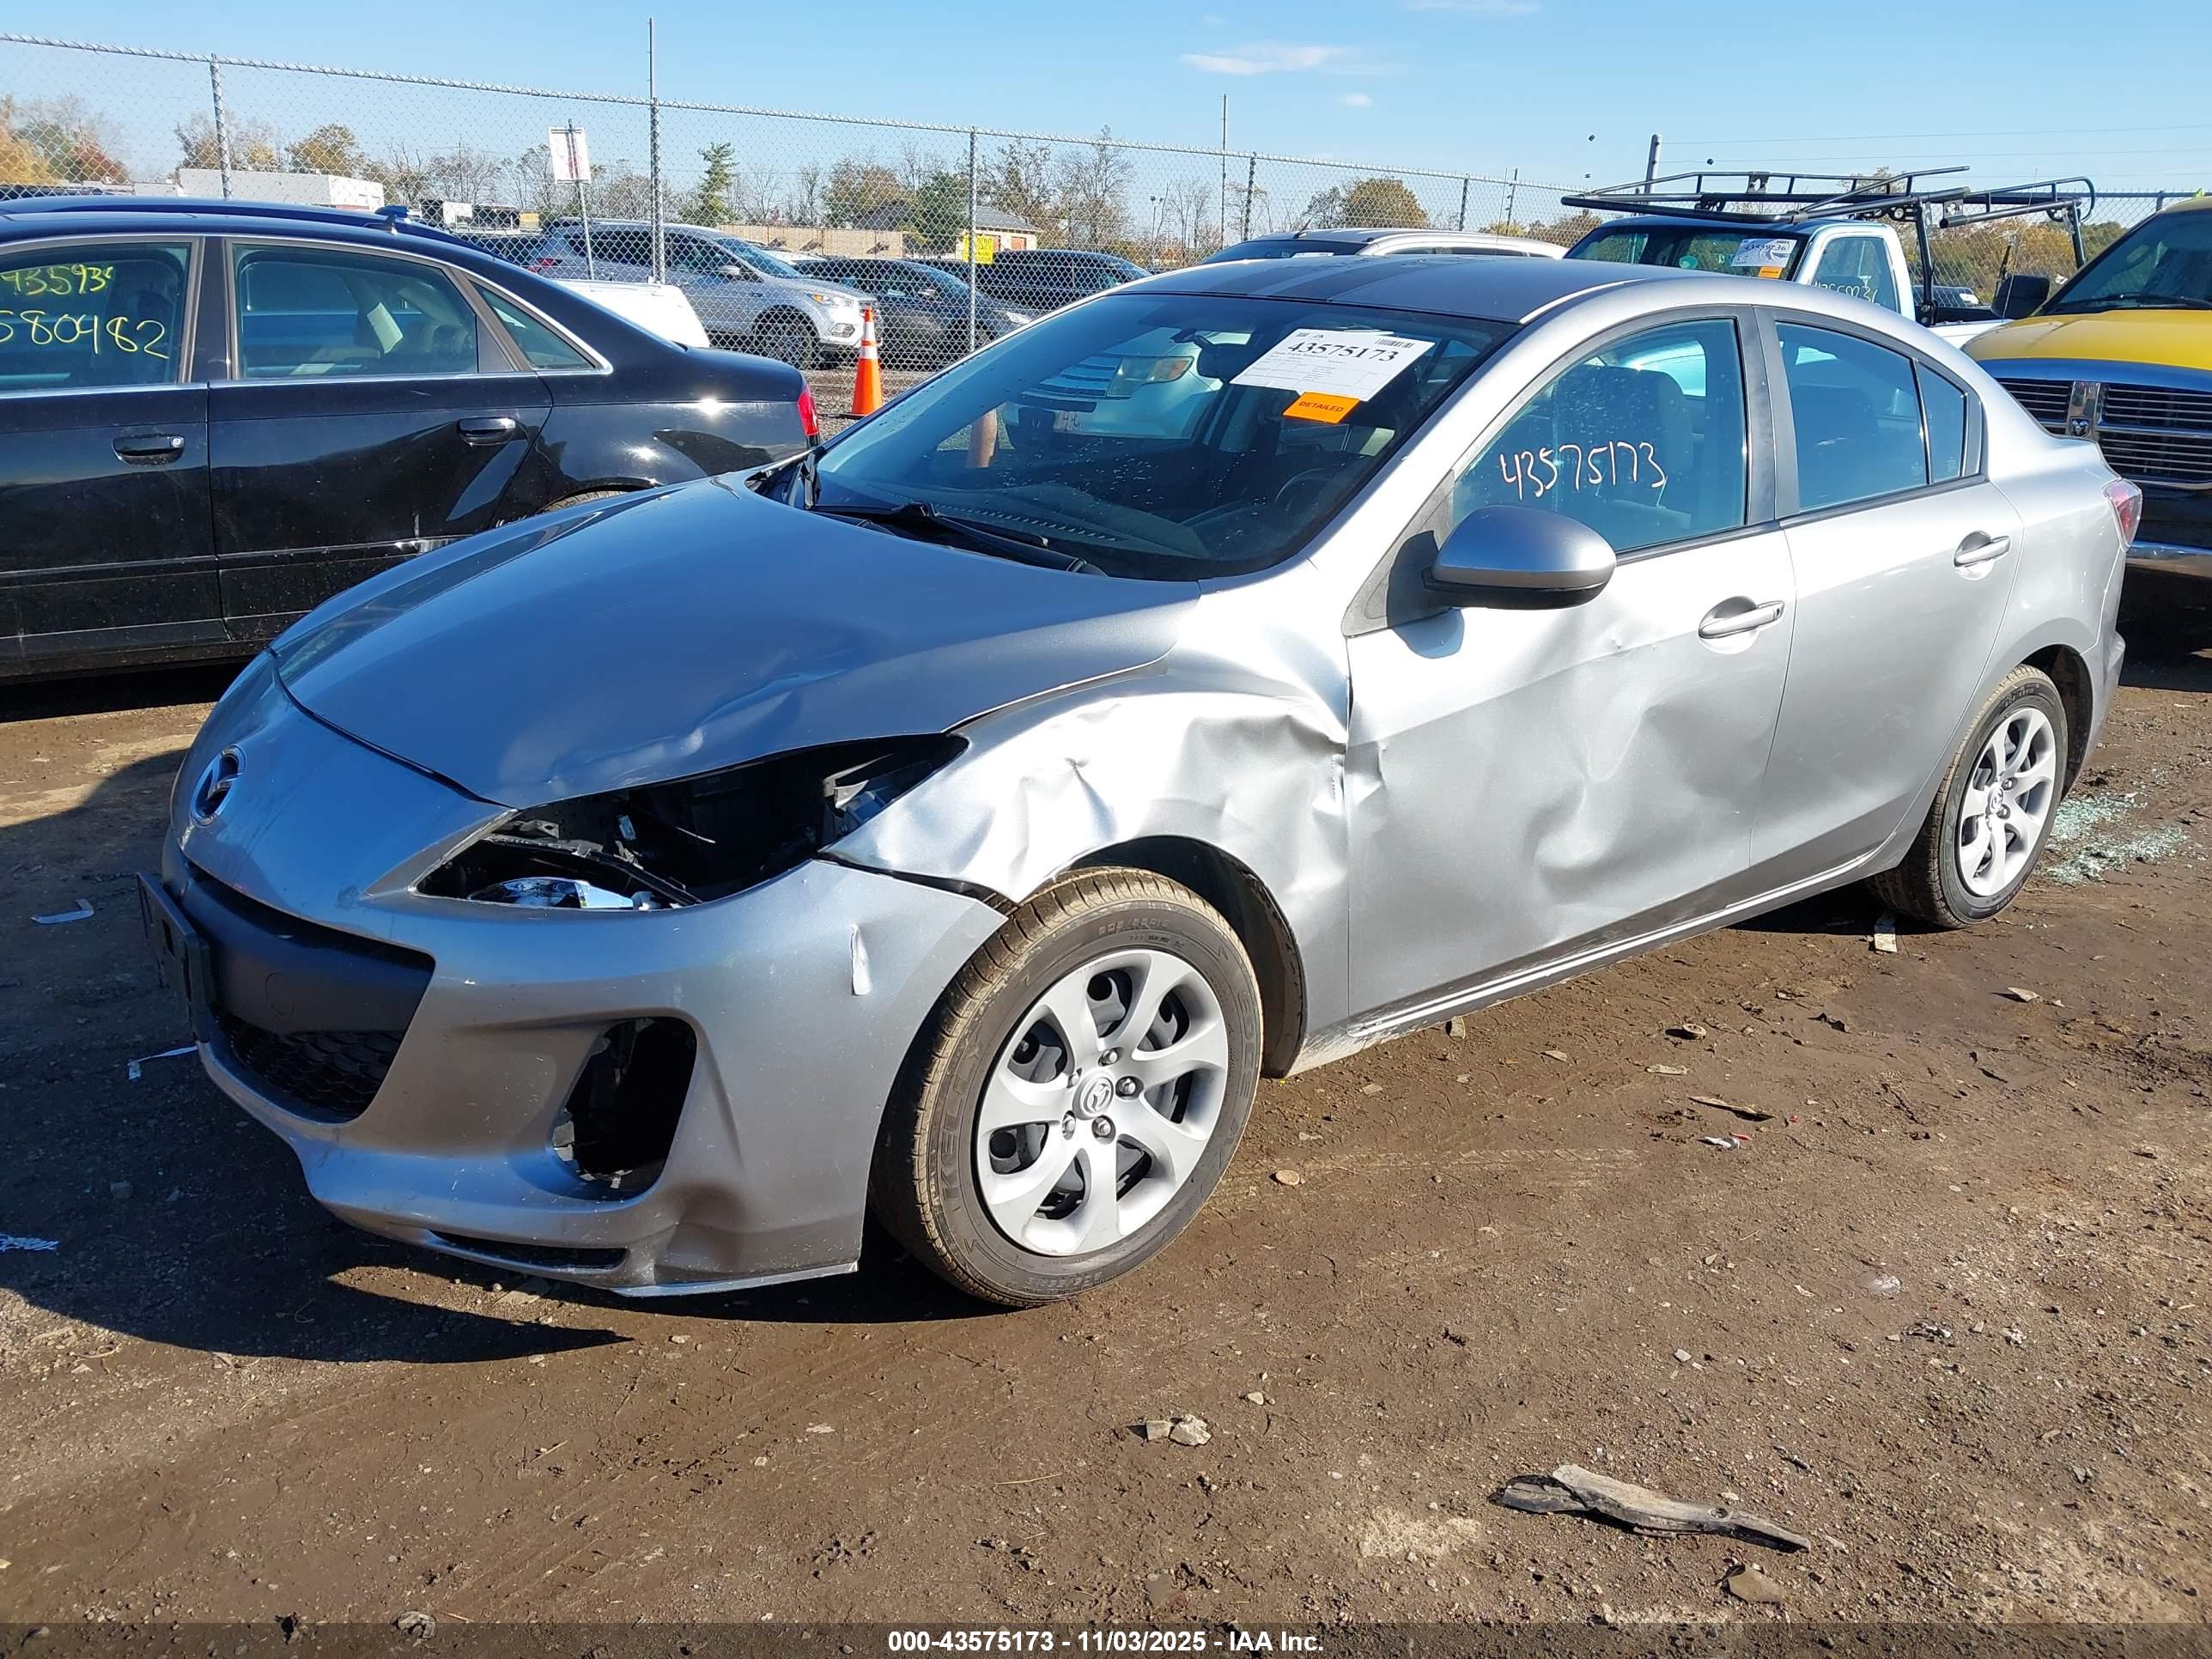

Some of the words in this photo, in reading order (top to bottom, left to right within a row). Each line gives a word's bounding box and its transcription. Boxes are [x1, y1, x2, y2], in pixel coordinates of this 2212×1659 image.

[1288, 342, 1399, 362] 43575173
[1299, 401, 1344, 412] DETAILED
[1499, 441, 1668, 501] 43575173
